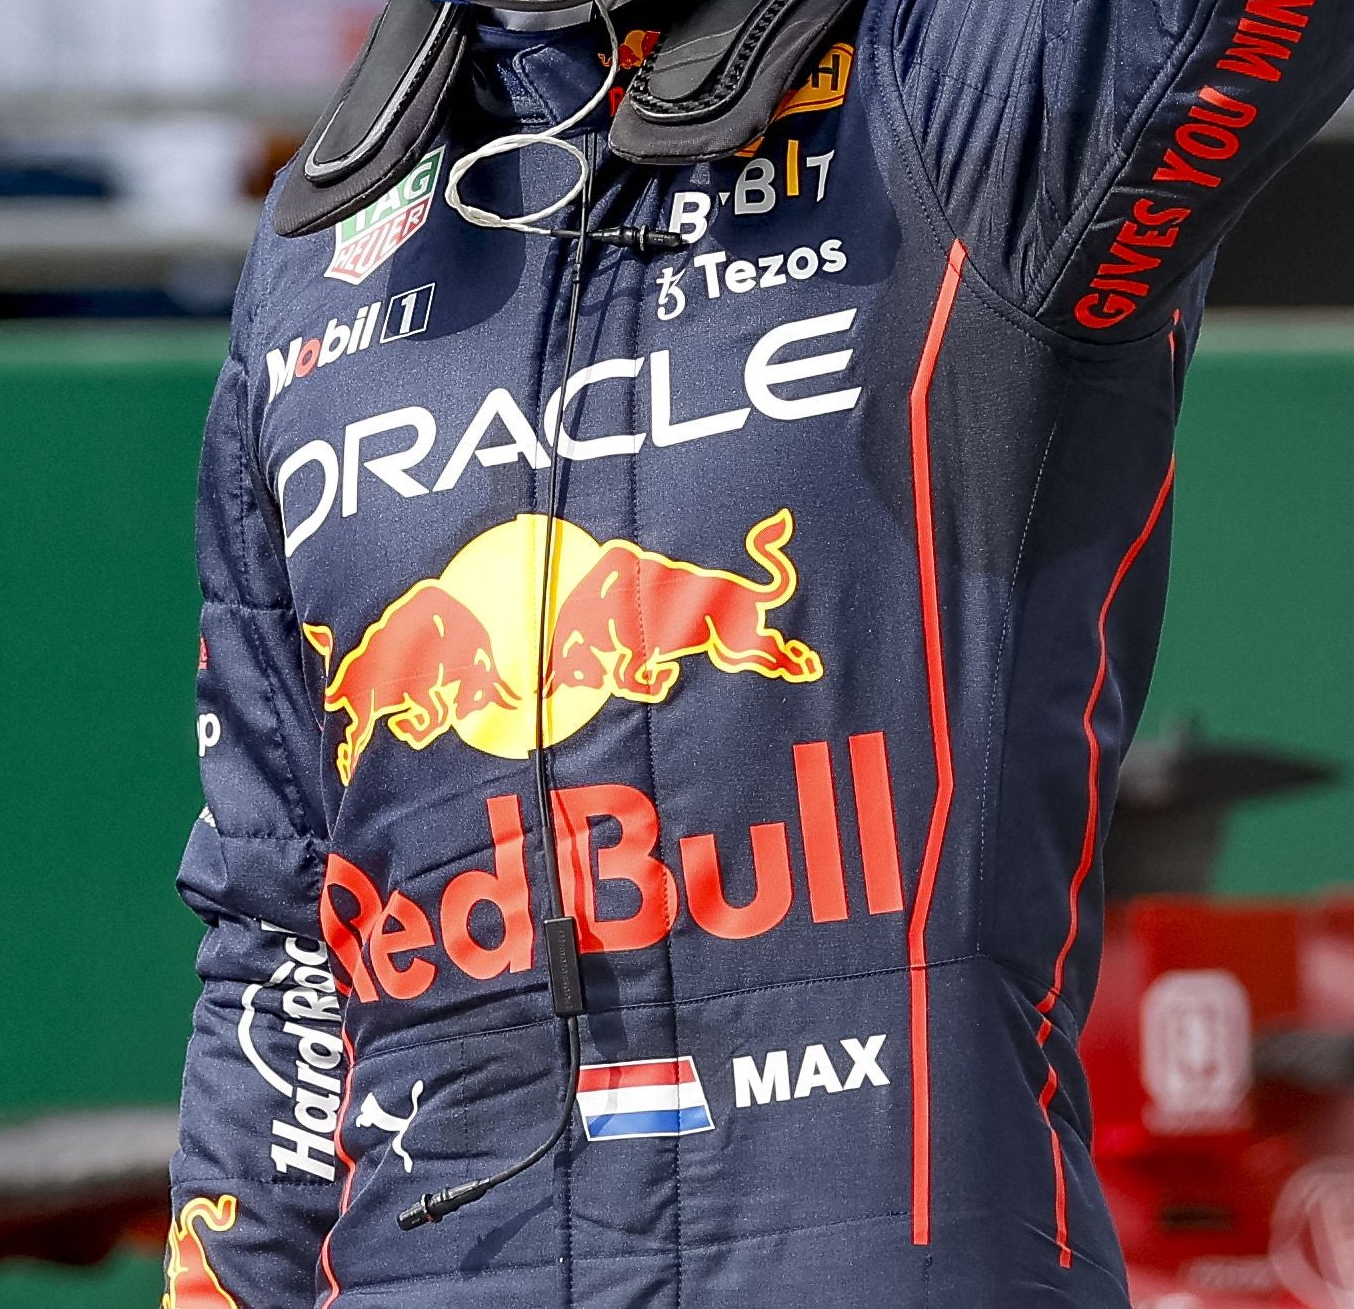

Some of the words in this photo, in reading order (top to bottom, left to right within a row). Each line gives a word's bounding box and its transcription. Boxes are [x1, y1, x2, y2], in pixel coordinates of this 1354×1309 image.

[335, 203, 425, 275] HEUER
[1074, 198, 1192, 329] GIVES
[1153, 85, 1258, 188] YOU
[694, 239, 847, 299] Tezos
[266, 301, 382, 404] Mobil
[277, 307, 862, 558] ORACLE
[270, 1021, 344, 1182] Hard
[733, 1034, 890, 1109] MAX
